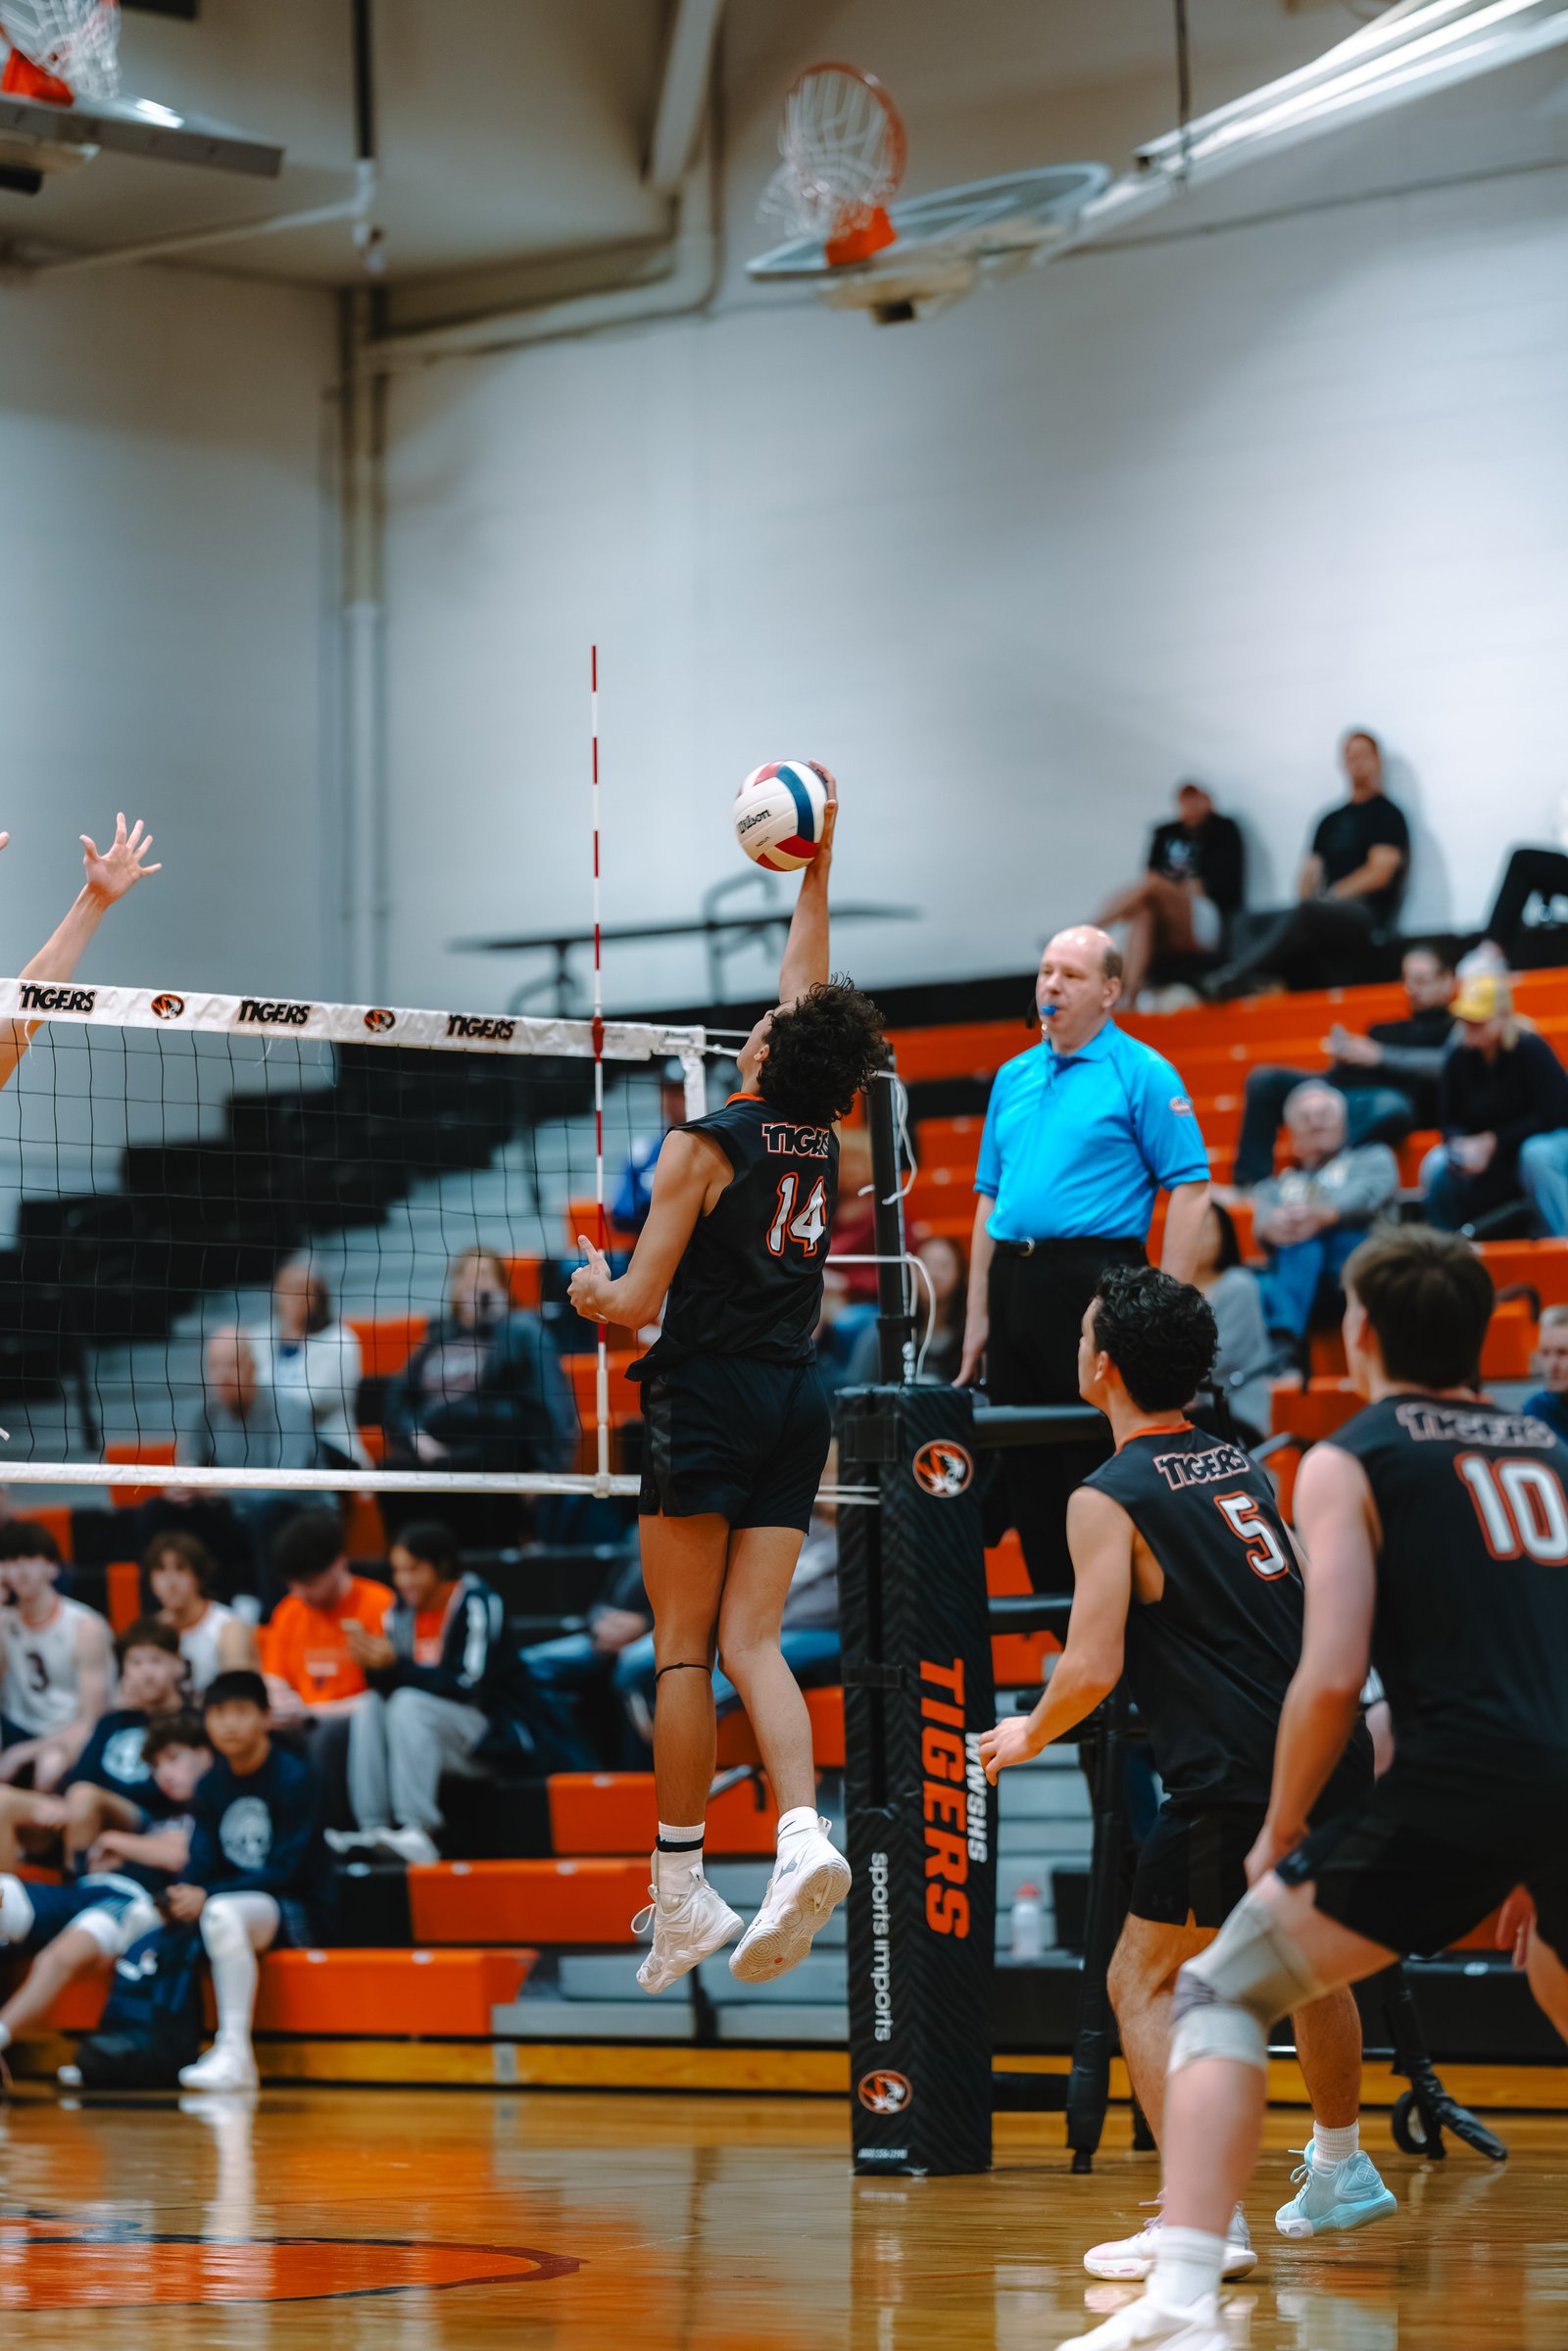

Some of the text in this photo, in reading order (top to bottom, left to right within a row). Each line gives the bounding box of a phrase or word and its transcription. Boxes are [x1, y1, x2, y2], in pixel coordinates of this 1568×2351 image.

[19, 983, 96, 1013] TIGERS
[238, 1000, 311, 1027] TIGERS
[446, 1014, 516, 1041] TIGERS
[766, 1172, 826, 1257] 14
[1152, 1444, 1250, 1491] TIGERS
[1213, 1490, 1289, 1581] 5
[1453, 1451, 1568, 1566] 10
[25, 1651, 50, 1693] 3
[919, 1657, 970, 1939] TIGERS
[868, 1852, 894, 2041] sports imports
